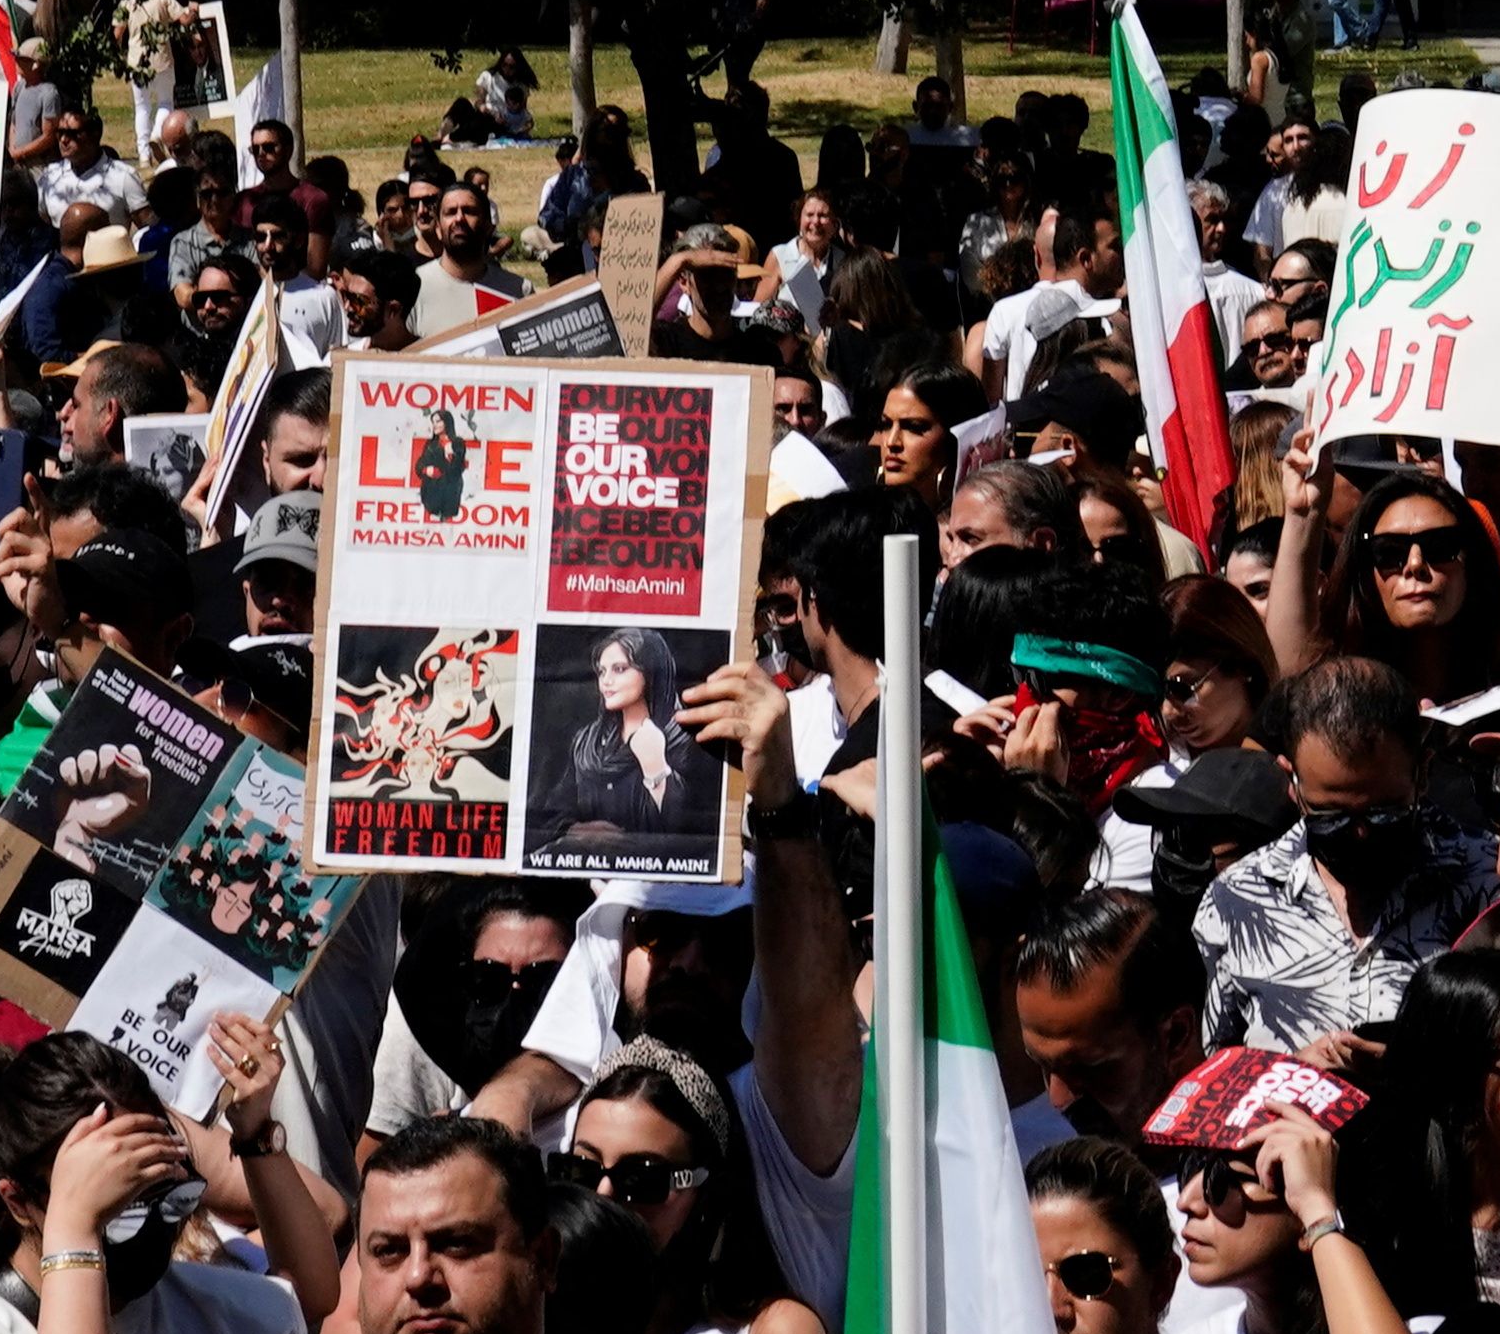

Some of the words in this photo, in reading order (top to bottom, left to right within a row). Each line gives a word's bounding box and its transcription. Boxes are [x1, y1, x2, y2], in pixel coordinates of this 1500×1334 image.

[1357, 122, 1476, 210] زن
[535, 302, 605, 345] women
[555, 341, 570, 352] for
[570, 325, 609, 346] women's
[576, 332, 612, 354] freedom
[360, 380, 535, 412] WOMEN
[569, 412, 620, 444] BE
[564, 443, 648, 476] OUR
[564, 474, 680, 508] VOICE
[356, 499, 530, 528] FREEDOM
[352, 528, 446, 549] MAHSA
[454, 531, 527, 551] AMINI
[566, 574, 685, 595] #MahsaAmini
[127, 684, 225, 763] women
[134, 720, 155, 740] for
[154, 733, 208, 776] women's
[151, 746, 202, 787] freedom
[333, 800, 433, 831] WOMAN
[445, 803, 502, 832] LIFE
[333, 829, 502, 859] FREEDOM
[529, 853, 553, 868] WE
[556, 854, 584, 868] ARE
[586, 855, 611, 869] ALL
[614, 856, 662, 871] MAHSA
[665, 858, 710, 873] AMINI
[16, 908, 96, 958] MAHSA
[120, 1008, 146, 1032] BE
[152, 1024, 191, 1062] OUR
[125, 1039, 180, 1083] VOICE
